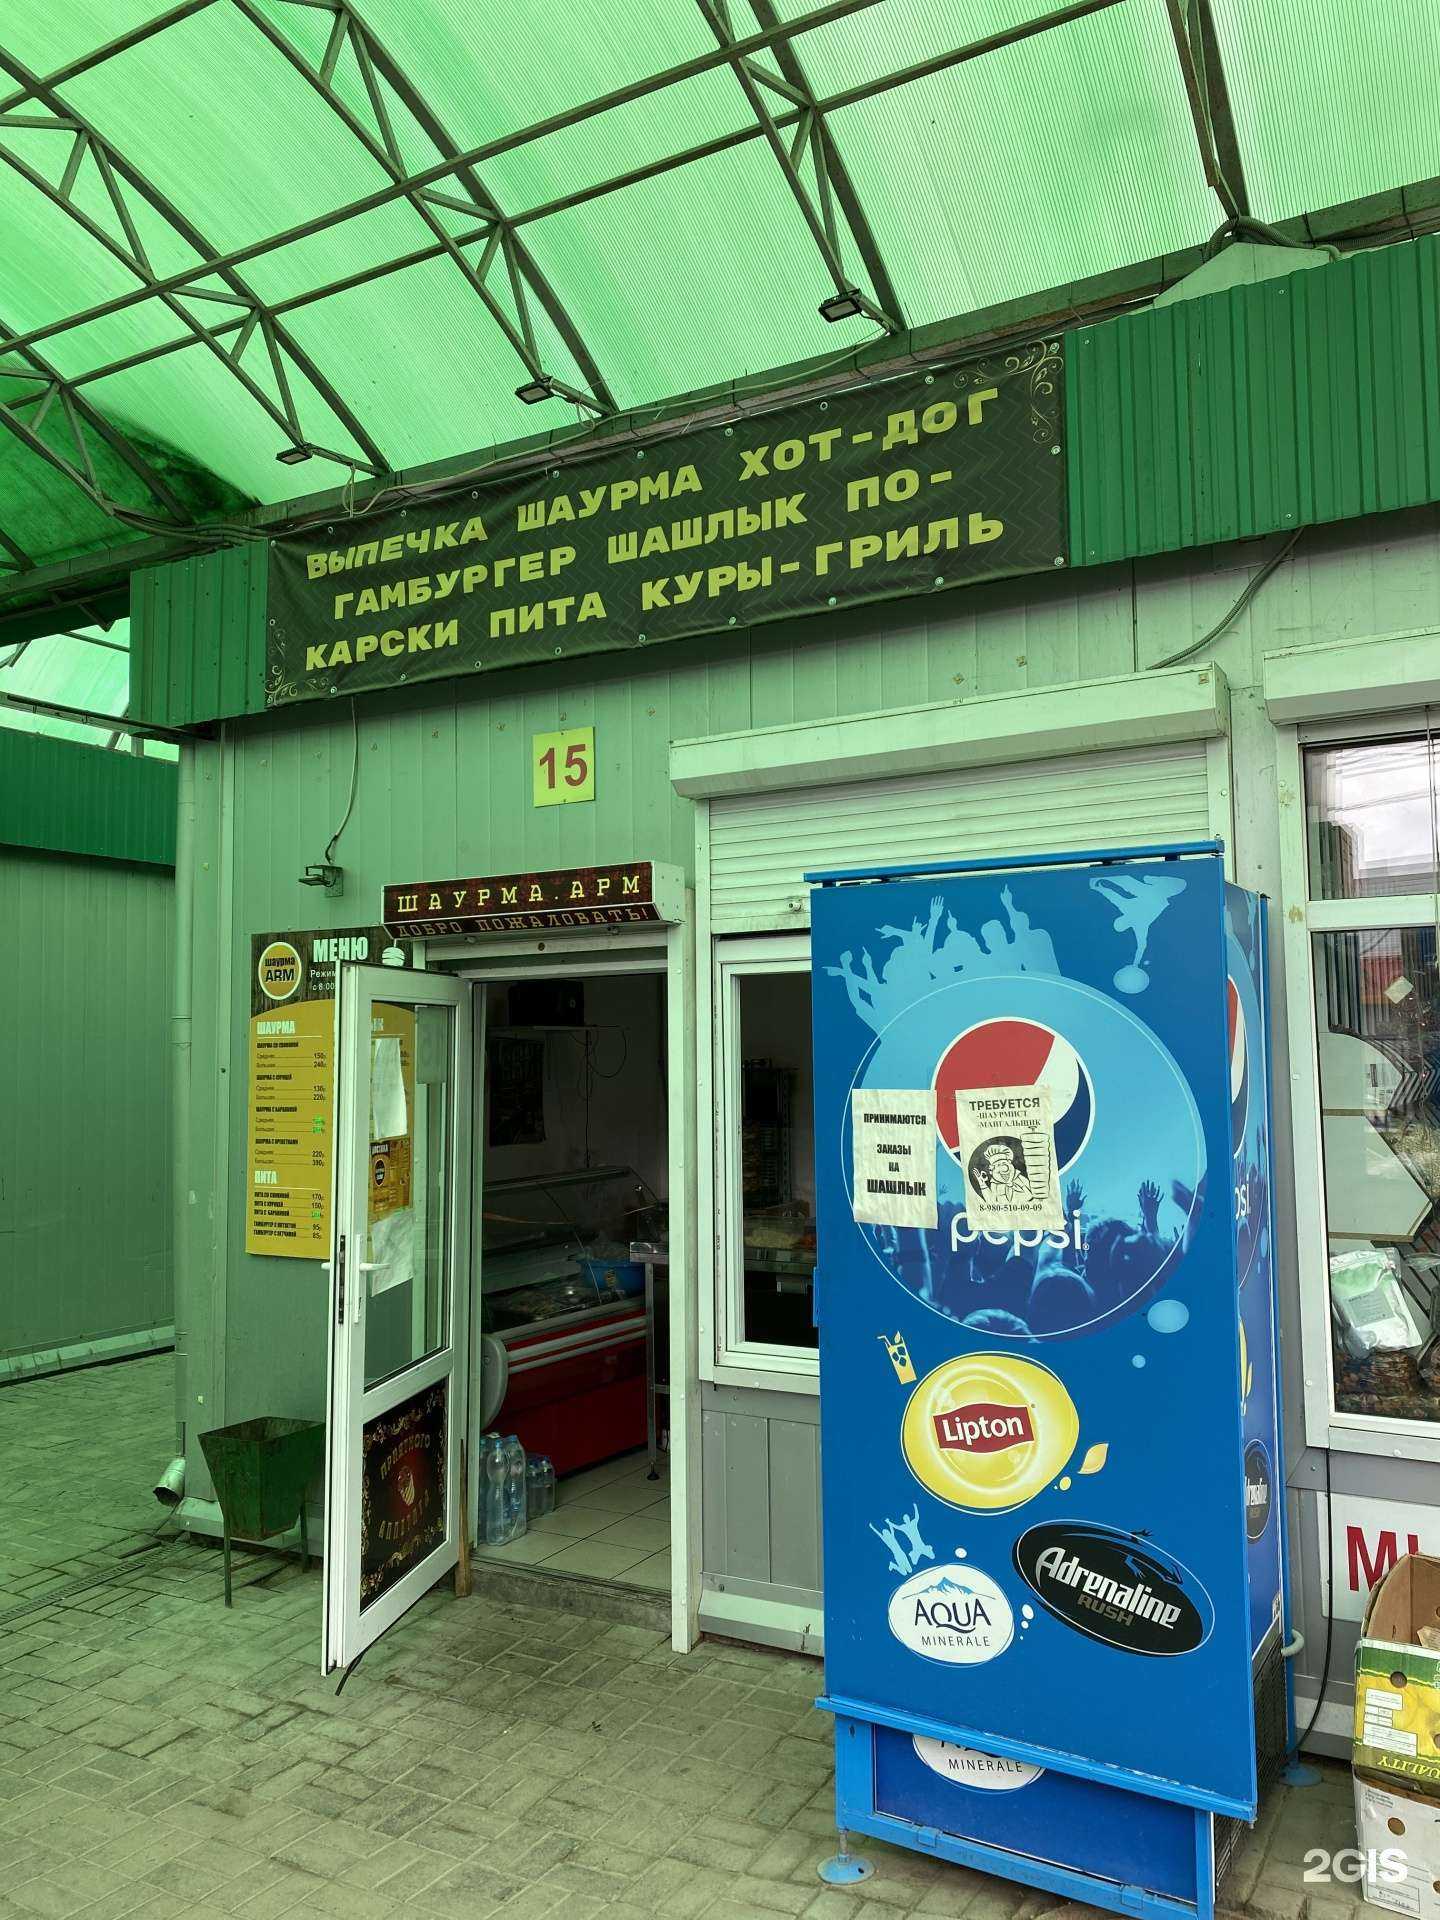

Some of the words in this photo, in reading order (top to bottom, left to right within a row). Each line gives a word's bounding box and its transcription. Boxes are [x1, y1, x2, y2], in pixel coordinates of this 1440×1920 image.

[306, 516, 488, 580] ВЫПЕЧКА
[517, 464, 703, 532] ШАУРМА
[334, 545, 577, 620] ГАМБУРГЕР
[607, 493, 807, 564] ШАШЛЫК
[847, 468, 952, 512] ПО-
[305, 619, 459, 671] КАРСКИ
[490, 591, 607, 638] ПИТА
[540, 744, 587, 789] 15
[398, 921, 463, 938] ДОБРО
[475, 906, 650, 932] ПОЖАЛОВАТЬ!
[313, 937, 368, 962] МЕНЮ
[257, 1020, 295, 1035] ШАУРМА
[969, 1097, 1040, 1111] ТРЕБУЕТСЯ
[863, 1112, 927, 1125] ПРИНИМАЮТСЯ
[877, 1143, 911, 1155] ЗАКАЗЫ
[255, 1170, 277, 1184] ПИТА
[888, 1162, 900, 1172] НА
[867, 1179, 926, 1196] ШАШЛЫК
[979, 1204, 1043, 1212] 8-980-510-09-09
[942, 1414, 1024, 1445] Lipton
[1035, 1546, 1182, 1630] Adrenaline
[914, 1597, 992, 1633] AQUA
[1077, 1593, 1136, 1626] RUSH
[921, 1635, 991, 1648] MINERALE
[948, 1757, 1023, 1773] MINERALE
